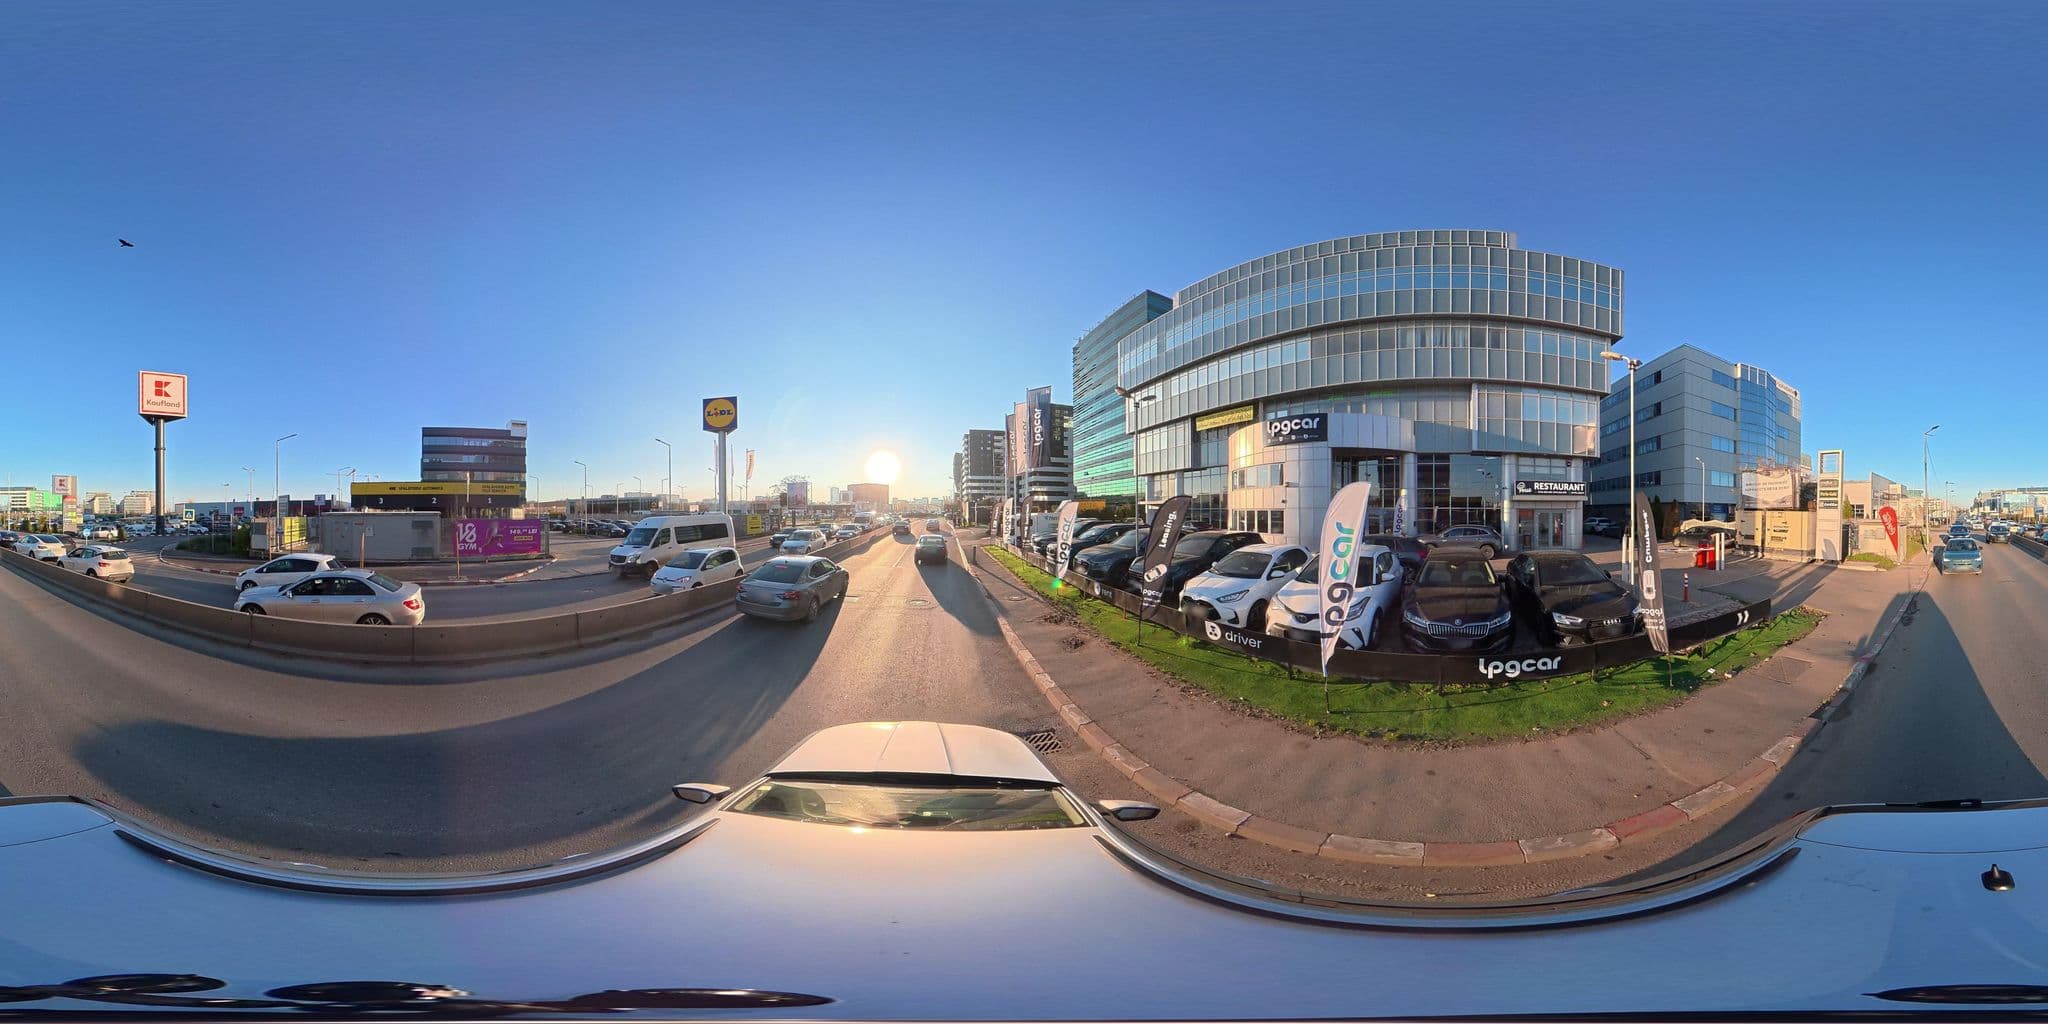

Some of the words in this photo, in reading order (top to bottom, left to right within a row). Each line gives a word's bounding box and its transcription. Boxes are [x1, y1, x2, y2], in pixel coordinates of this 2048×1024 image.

[146, 400, 181, 408] Kaufland
[1034, 409, 1044, 446] lpgcar
[1267, 417, 1320, 437] lpgcar
[1534, 482, 1585, 491] RESTAURANT
[458, 543, 477, 551] GYM
[1320, 521, 1355, 638] lpgcar
[1225, 630, 1262, 649] driver
[1479, 656, 1562, 679] lpgcar
